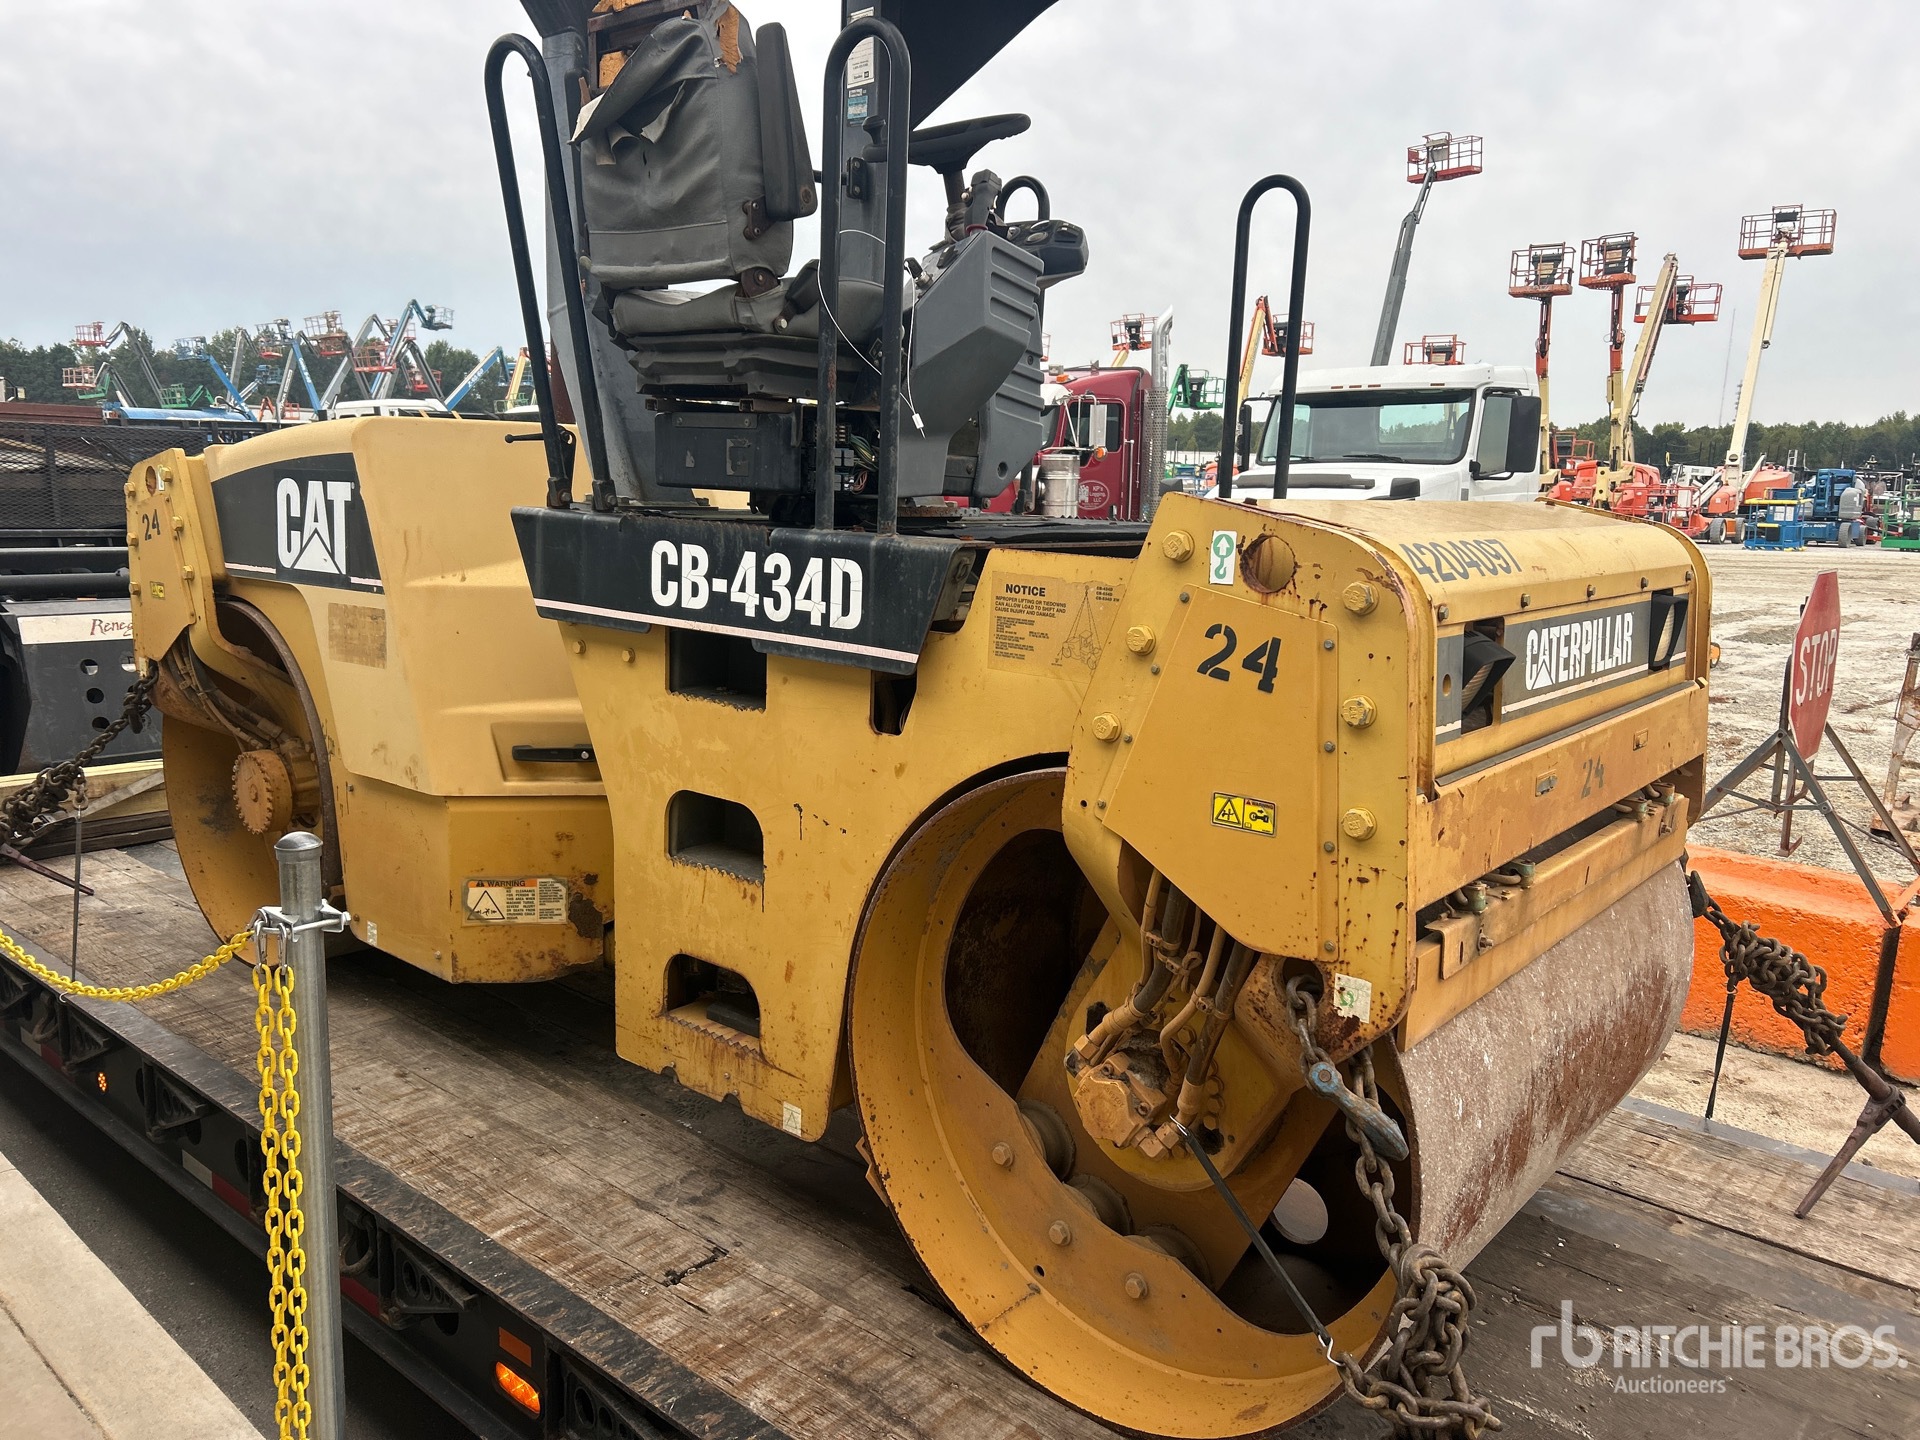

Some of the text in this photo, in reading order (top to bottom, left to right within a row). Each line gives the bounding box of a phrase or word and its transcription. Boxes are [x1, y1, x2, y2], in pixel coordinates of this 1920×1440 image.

[142, 509, 160, 541] 24
[277, 478, 351, 574] CAT
[651, 540, 863, 630] CB-434D
[1399, 539, 1522, 583] 4204097
[995, 595, 1018, 603] IMPROPER
[1018, 597, 1035, 605] LIFTING
[1005, 583, 1046, 597] NOTICE
[1197, 624, 1281, 694] 24
[1526, 612, 1634, 690] CATERPILLAR
[1796, 628, 1838, 707] STOP
[1581, 755, 1605, 800] 24
